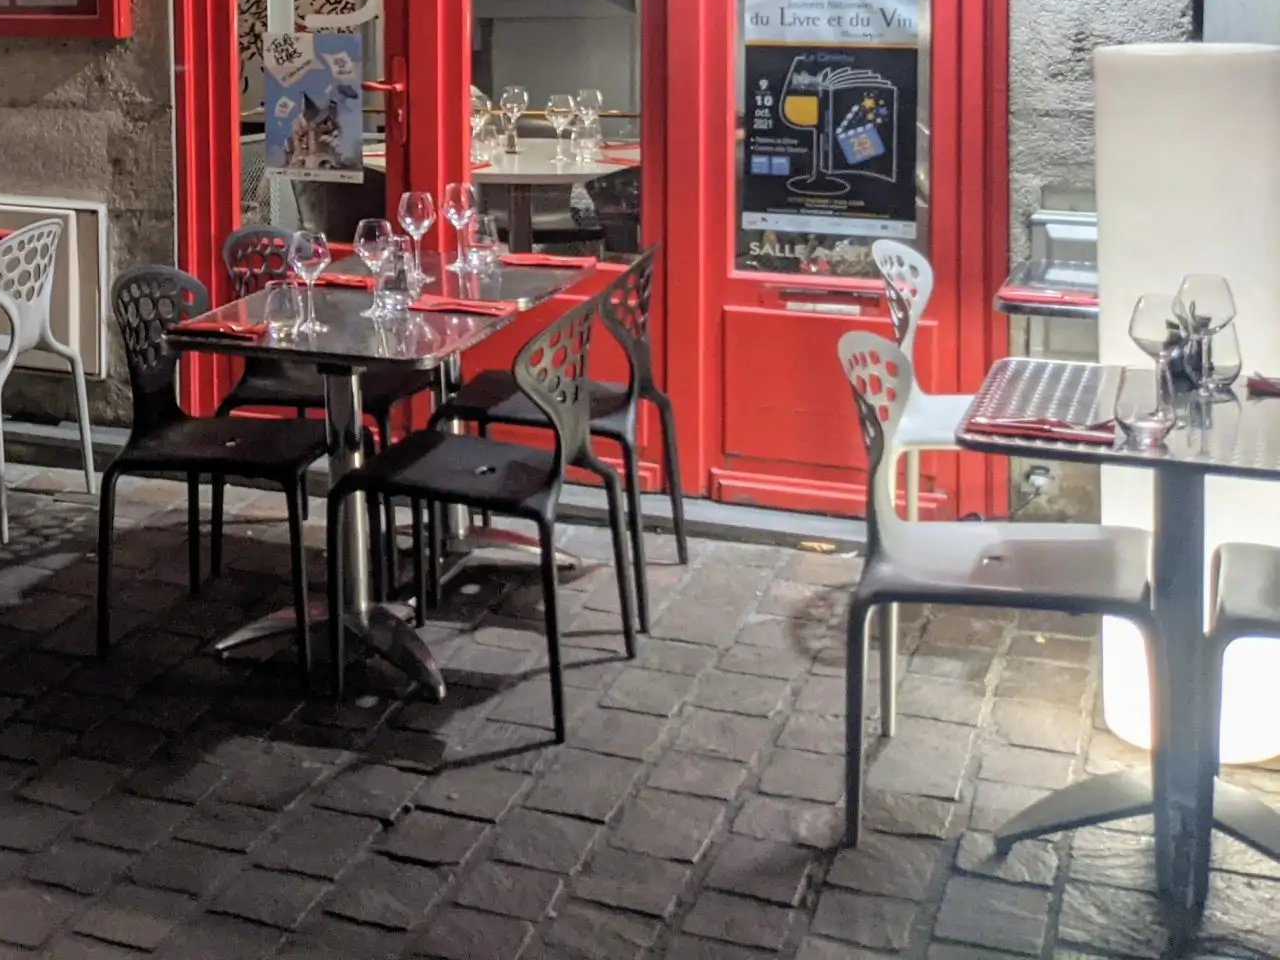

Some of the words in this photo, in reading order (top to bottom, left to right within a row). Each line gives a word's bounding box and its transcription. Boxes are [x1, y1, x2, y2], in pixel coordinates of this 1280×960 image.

[749, 12, 770, 27] du
[779, 6, 822, 28] Livre
[827, 14, 844, 28] et
[849, 13, 871, 28] du
[878, 7, 913, 29] Vin
[758, 78, 770, 91] 9
[754, 94, 774, 107] 10
[748, 241, 807, 260] SALLE
